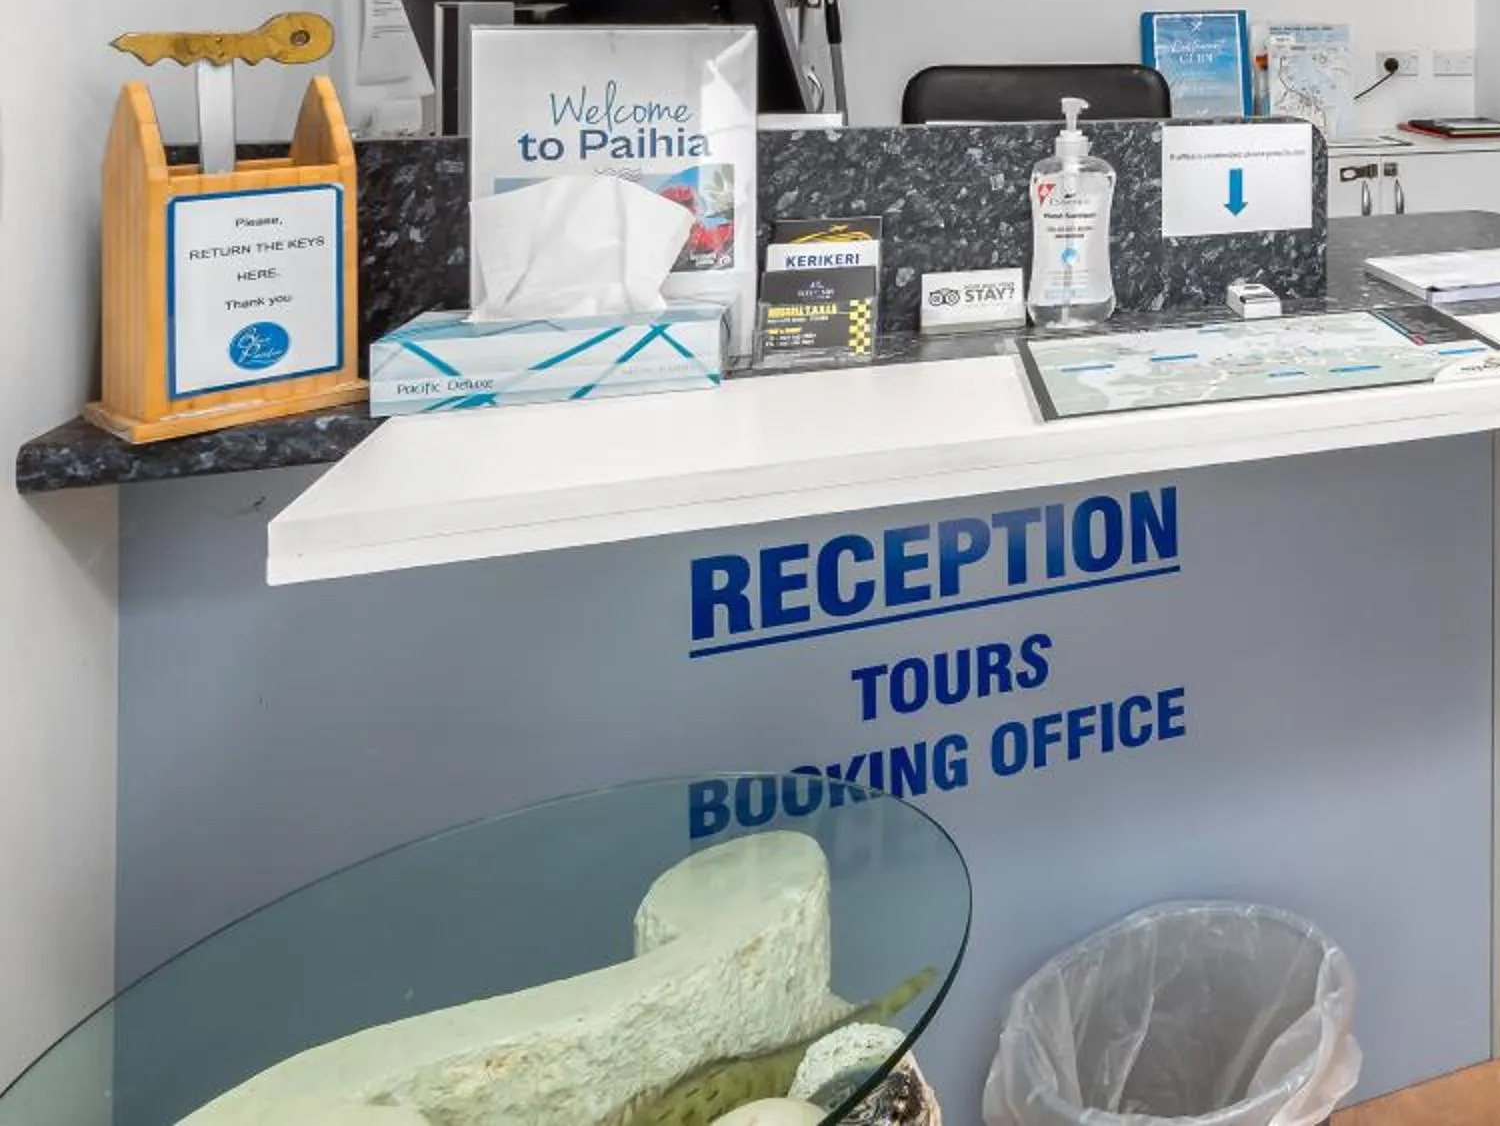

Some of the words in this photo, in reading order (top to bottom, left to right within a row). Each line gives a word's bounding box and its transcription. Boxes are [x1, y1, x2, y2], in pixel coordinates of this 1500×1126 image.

[550, 80, 696, 128] Welcome
[518, 130, 565, 162] to
[579, 128, 714, 161] Paihia
[235, 215, 284, 228] Please,
[189, 244, 251, 260] RETURN
[256, 241, 284, 254] THE
[287, 235, 325, 250] KEYS
[785, 253, 860, 268] KERIKERI
[225, 296, 265, 311] Thank
[268, 293, 292, 307] you
[964, 286, 1015, 303] STAY?
[396, 382, 440, 395] Pacific
[447, 377, 494, 391] Deluxe
[689, 486, 1179, 642] RECEPTION
[851, 633, 1052, 722] TOURS
[688, 733, 969, 840] BOOKING
[990, 687, 1186, 777] OFFICE
